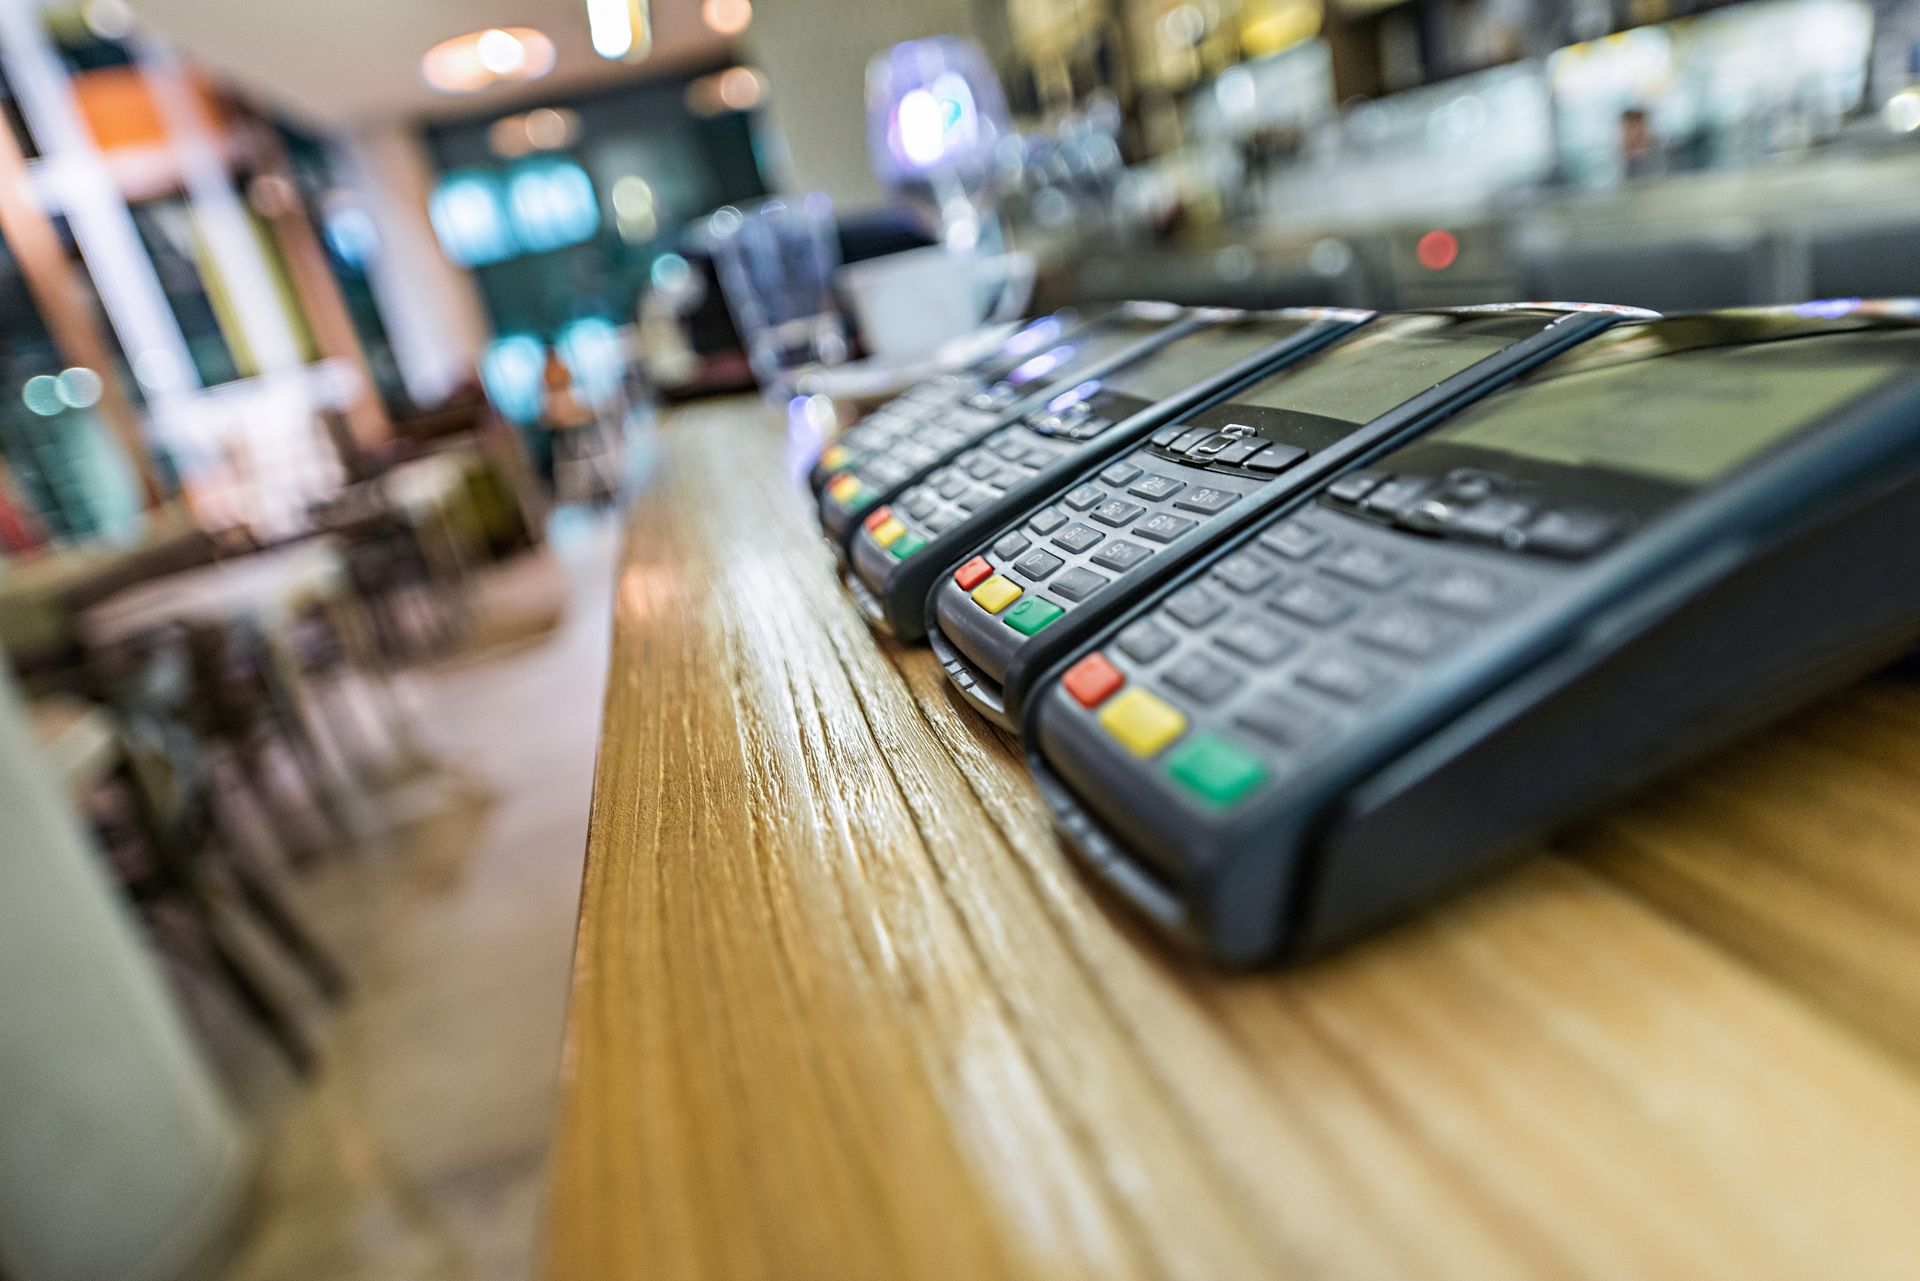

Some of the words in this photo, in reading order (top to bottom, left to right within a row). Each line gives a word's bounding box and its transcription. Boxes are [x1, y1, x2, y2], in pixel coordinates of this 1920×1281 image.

[1191, 489, 1210, 501] 3
[1148, 515, 1167, 528] 6
[1105, 543, 1125, 556] 9
